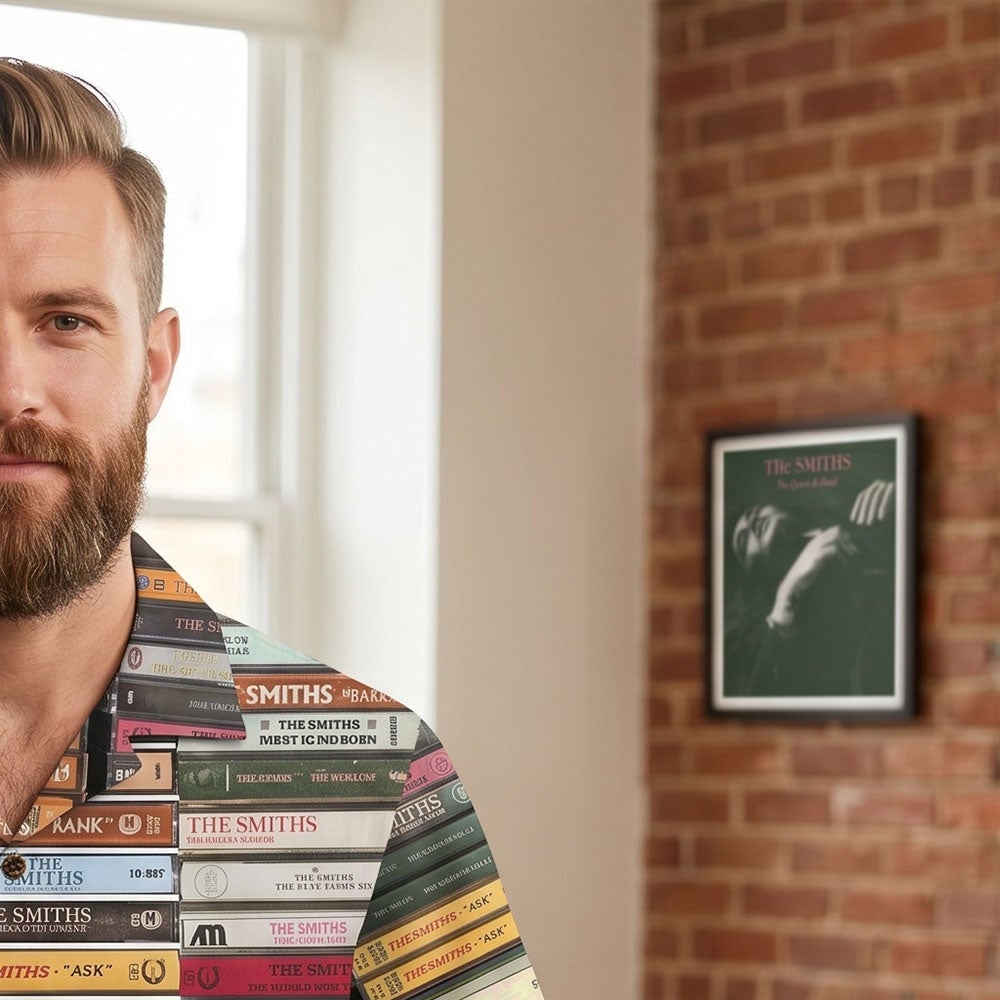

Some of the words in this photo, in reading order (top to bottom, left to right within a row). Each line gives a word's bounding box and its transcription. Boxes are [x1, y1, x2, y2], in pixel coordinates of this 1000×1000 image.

[795, 454, 851, 474] SMITHS
[175, 618, 204, 631] THE
[245, 684, 333, 705] SMITHS
[278, 720, 304, 730] THE
[308, 720, 361, 730] SMITHS
[187, 816, 232, 834] THE
[236, 815, 317, 833] SMITHS
[29, 858, 63, 870] THE
[4, 870, 83, 886] SMITHS
[275, 883, 295, 891] THE
[12, 907, 92, 923] SMITHS
[269, 922, 295, 935] THE
[298, 922, 347, 934] SMITHS
[387, 911, 458, 953] THESMITHS
[269, 964, 302, 976] THE
[403, 942, 473, 984] THESMITHS
